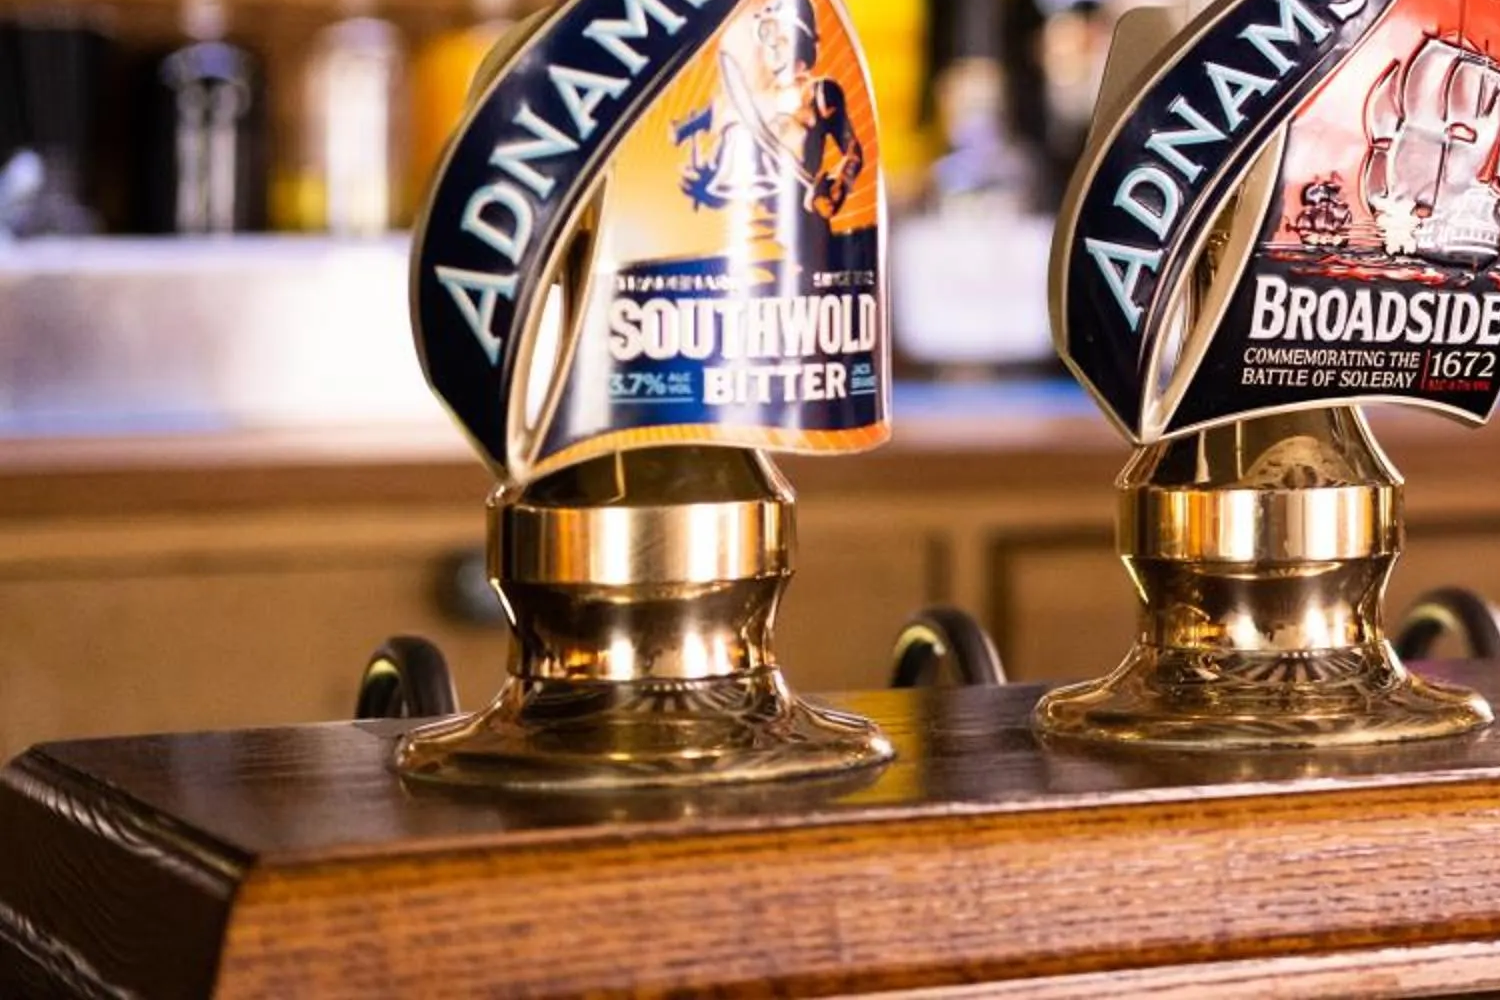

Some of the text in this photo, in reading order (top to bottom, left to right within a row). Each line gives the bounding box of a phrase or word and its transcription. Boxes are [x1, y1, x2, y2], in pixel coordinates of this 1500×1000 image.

[609, 293, 877, 361] SOUTHWOLD
[1243, 347, 1421, 369] COMMEMORATING THE
[1429, 350, 1497, 378] 1672
[702, 361, 847, 405] BITTER
[1241, 367, 1417, 389] BATTLE OF SOLEBAY
